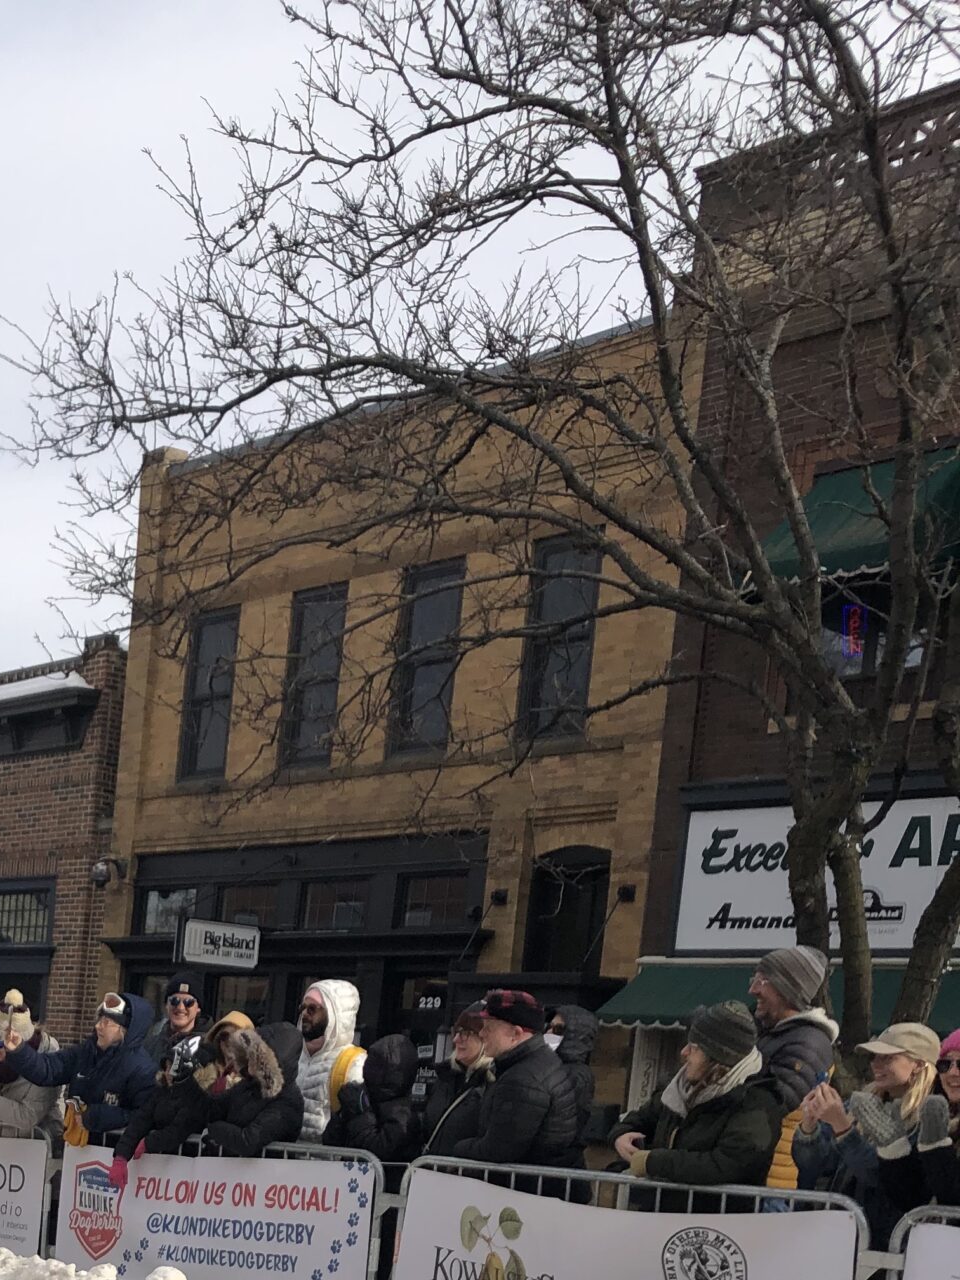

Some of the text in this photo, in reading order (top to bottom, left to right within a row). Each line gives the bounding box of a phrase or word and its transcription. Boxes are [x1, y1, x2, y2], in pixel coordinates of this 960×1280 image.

[419, 997, 441, 1008] 229
[79, 1190, 114, 1213] KLONDIKE
[135, 1176, 339, 1213] FOLLOW US ON SOCIAL!
[70, 1210, 122, 1238] Dog Derby
[146, 1212, 315, 1245] @KLONDIKEDOGDERBY
[667, 1230, 710, 1255] OTHERS
[714, 1234, 739, 1257] MAY
[157, 1245, 298, 1273] #KLONDIKEDOGDERBY
